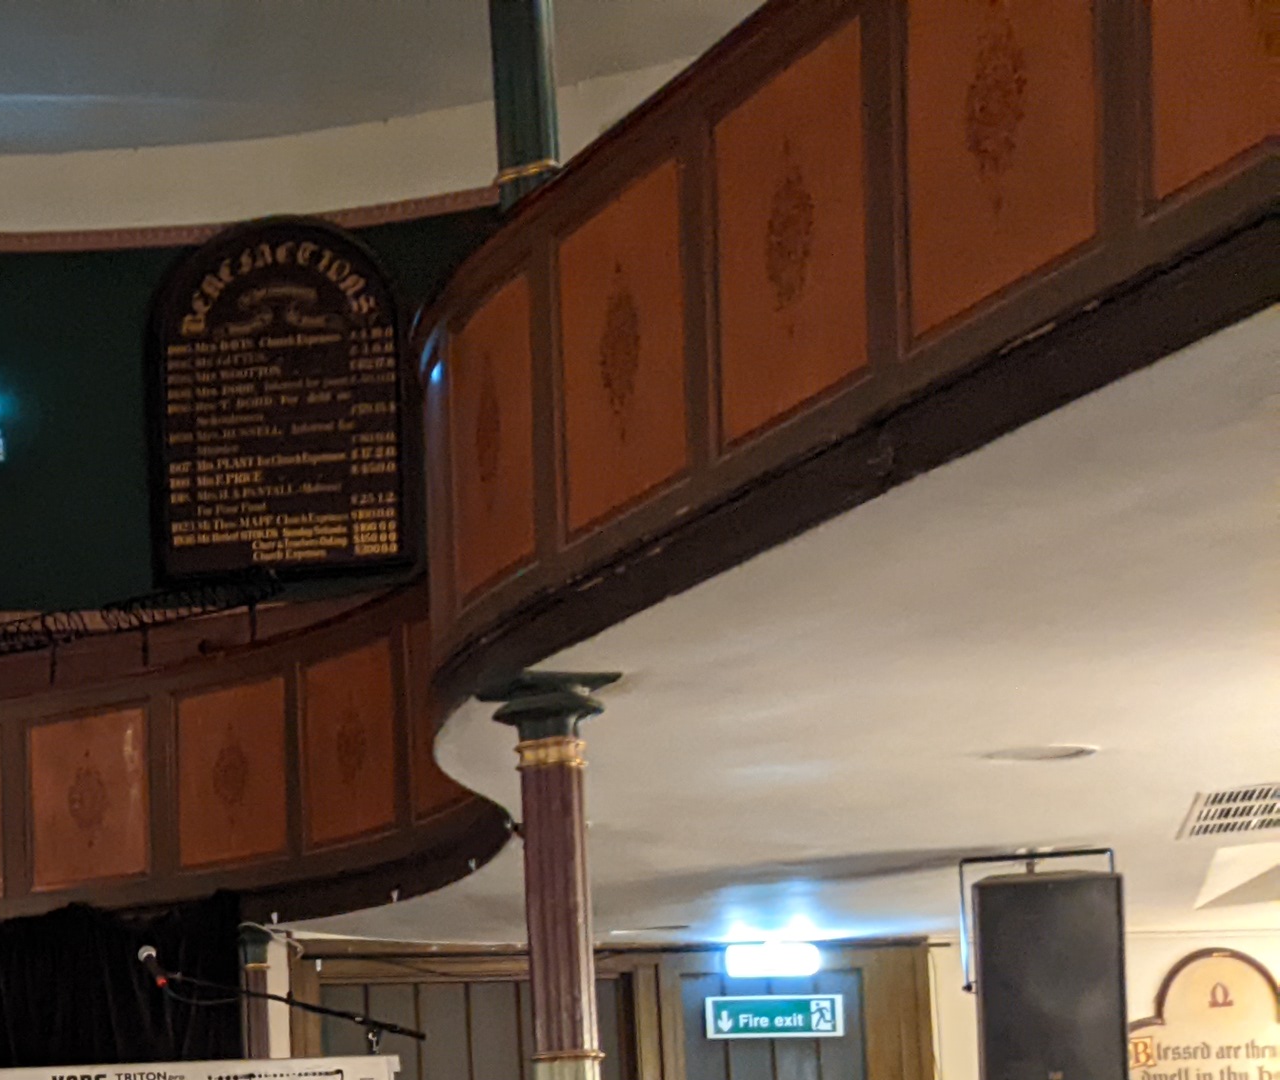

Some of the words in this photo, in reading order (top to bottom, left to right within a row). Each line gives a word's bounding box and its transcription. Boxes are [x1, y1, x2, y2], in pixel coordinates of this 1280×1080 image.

[739, 1014, 770, 1027] Fire
[774, 1013, 804, 1027] exit
[1131, 1039, 1211, 1066] Blessed
[1215, 1045, 1242, 1060] are
